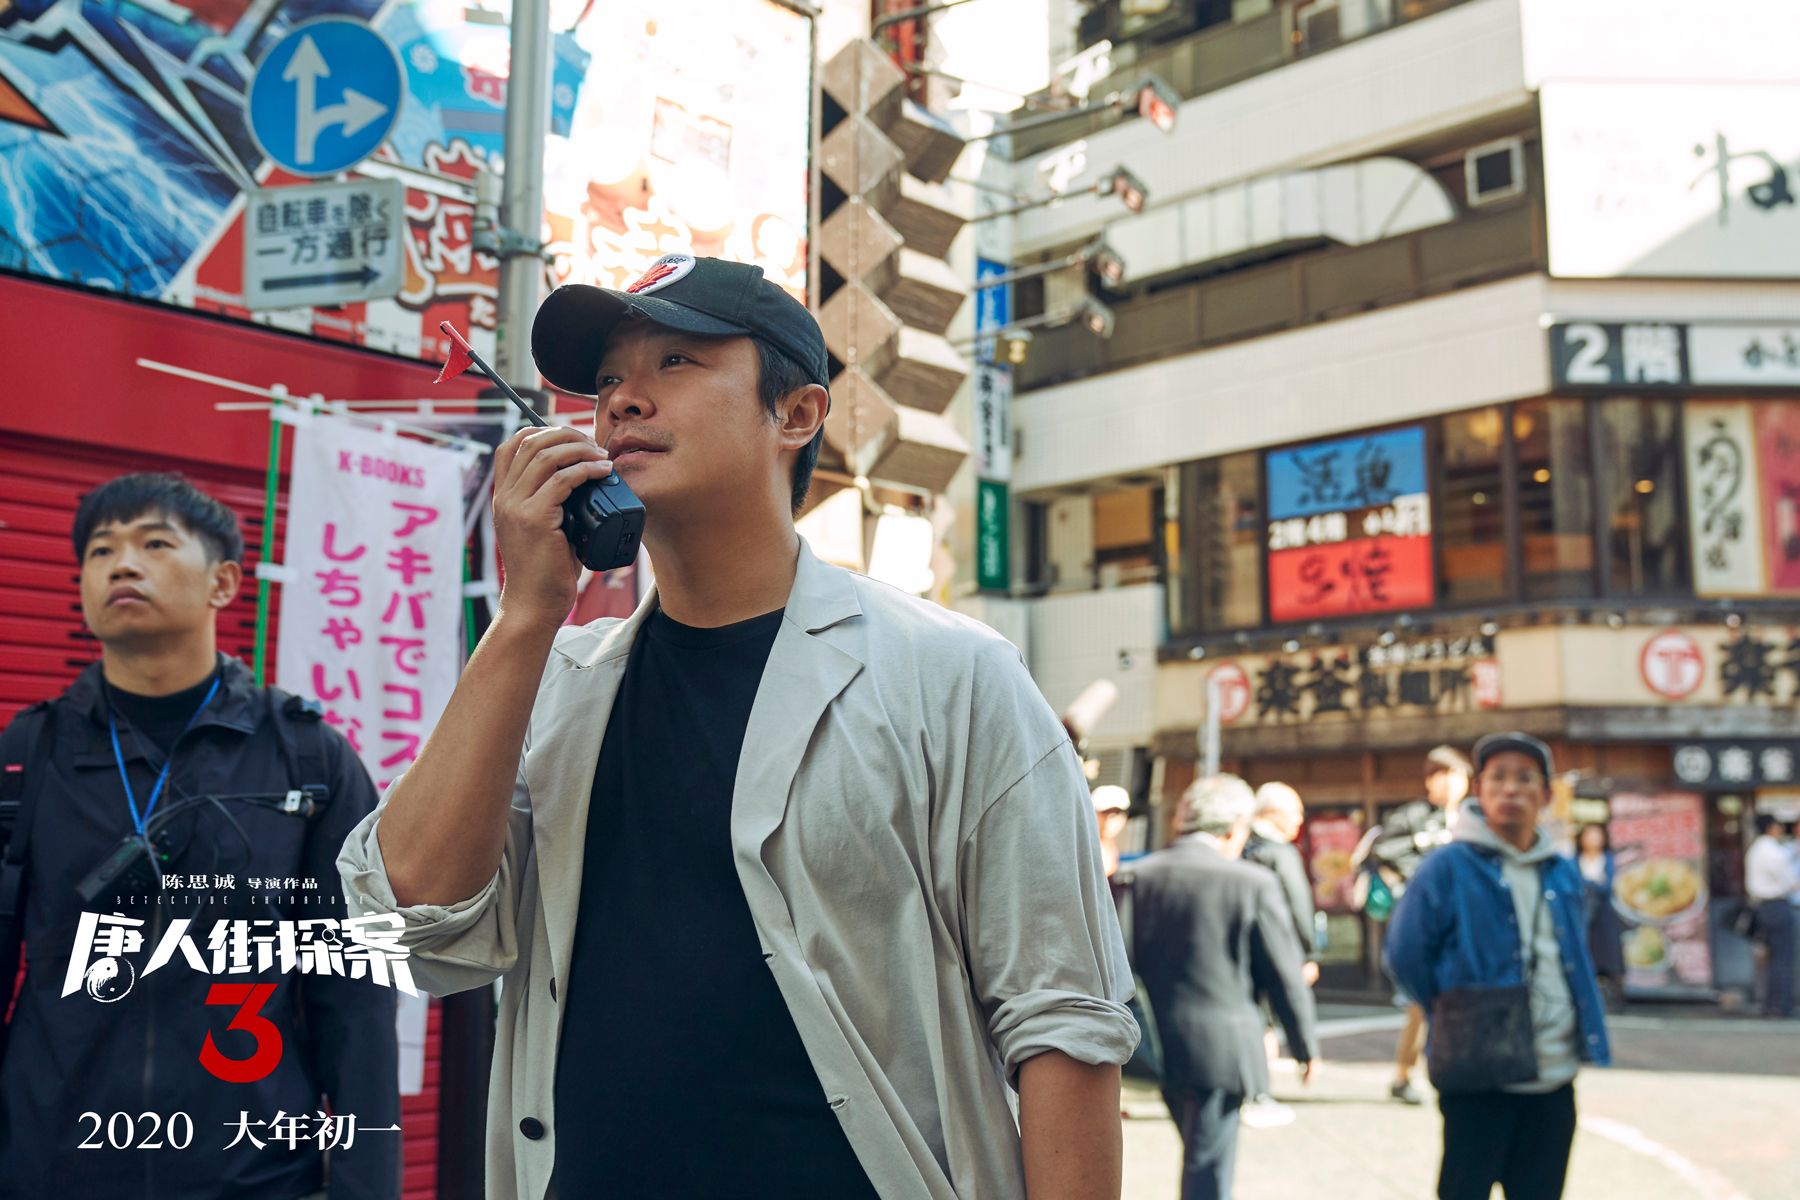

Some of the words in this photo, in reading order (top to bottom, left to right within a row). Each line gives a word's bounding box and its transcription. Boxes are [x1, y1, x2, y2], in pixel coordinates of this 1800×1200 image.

[257, 193, 391, 234] 自転車を除く
[256, 228, 390, 266] 一方通行
[1563, 324, 1682, 385] 2階
[339, 450, 427, 489] K-BOOKS
[377, 501, 440, 792] アキバでコス
